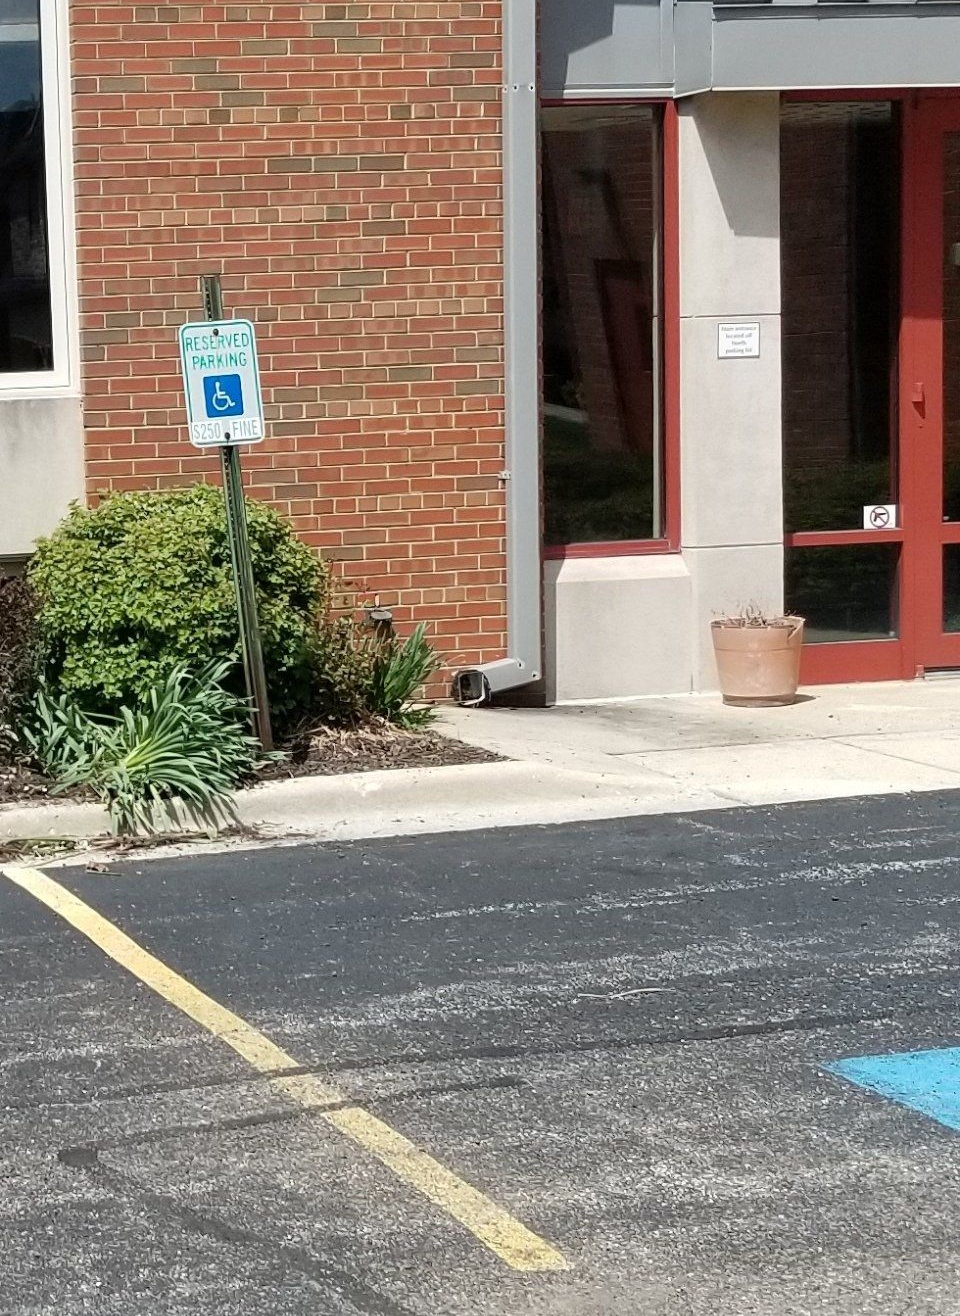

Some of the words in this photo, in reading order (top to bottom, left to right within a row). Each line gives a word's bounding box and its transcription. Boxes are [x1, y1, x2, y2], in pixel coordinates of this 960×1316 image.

[186, 333, 249, 352] RESERVED
[192, 352, 247, 370] PARKING
[232, 419, 259, 437] FINE
